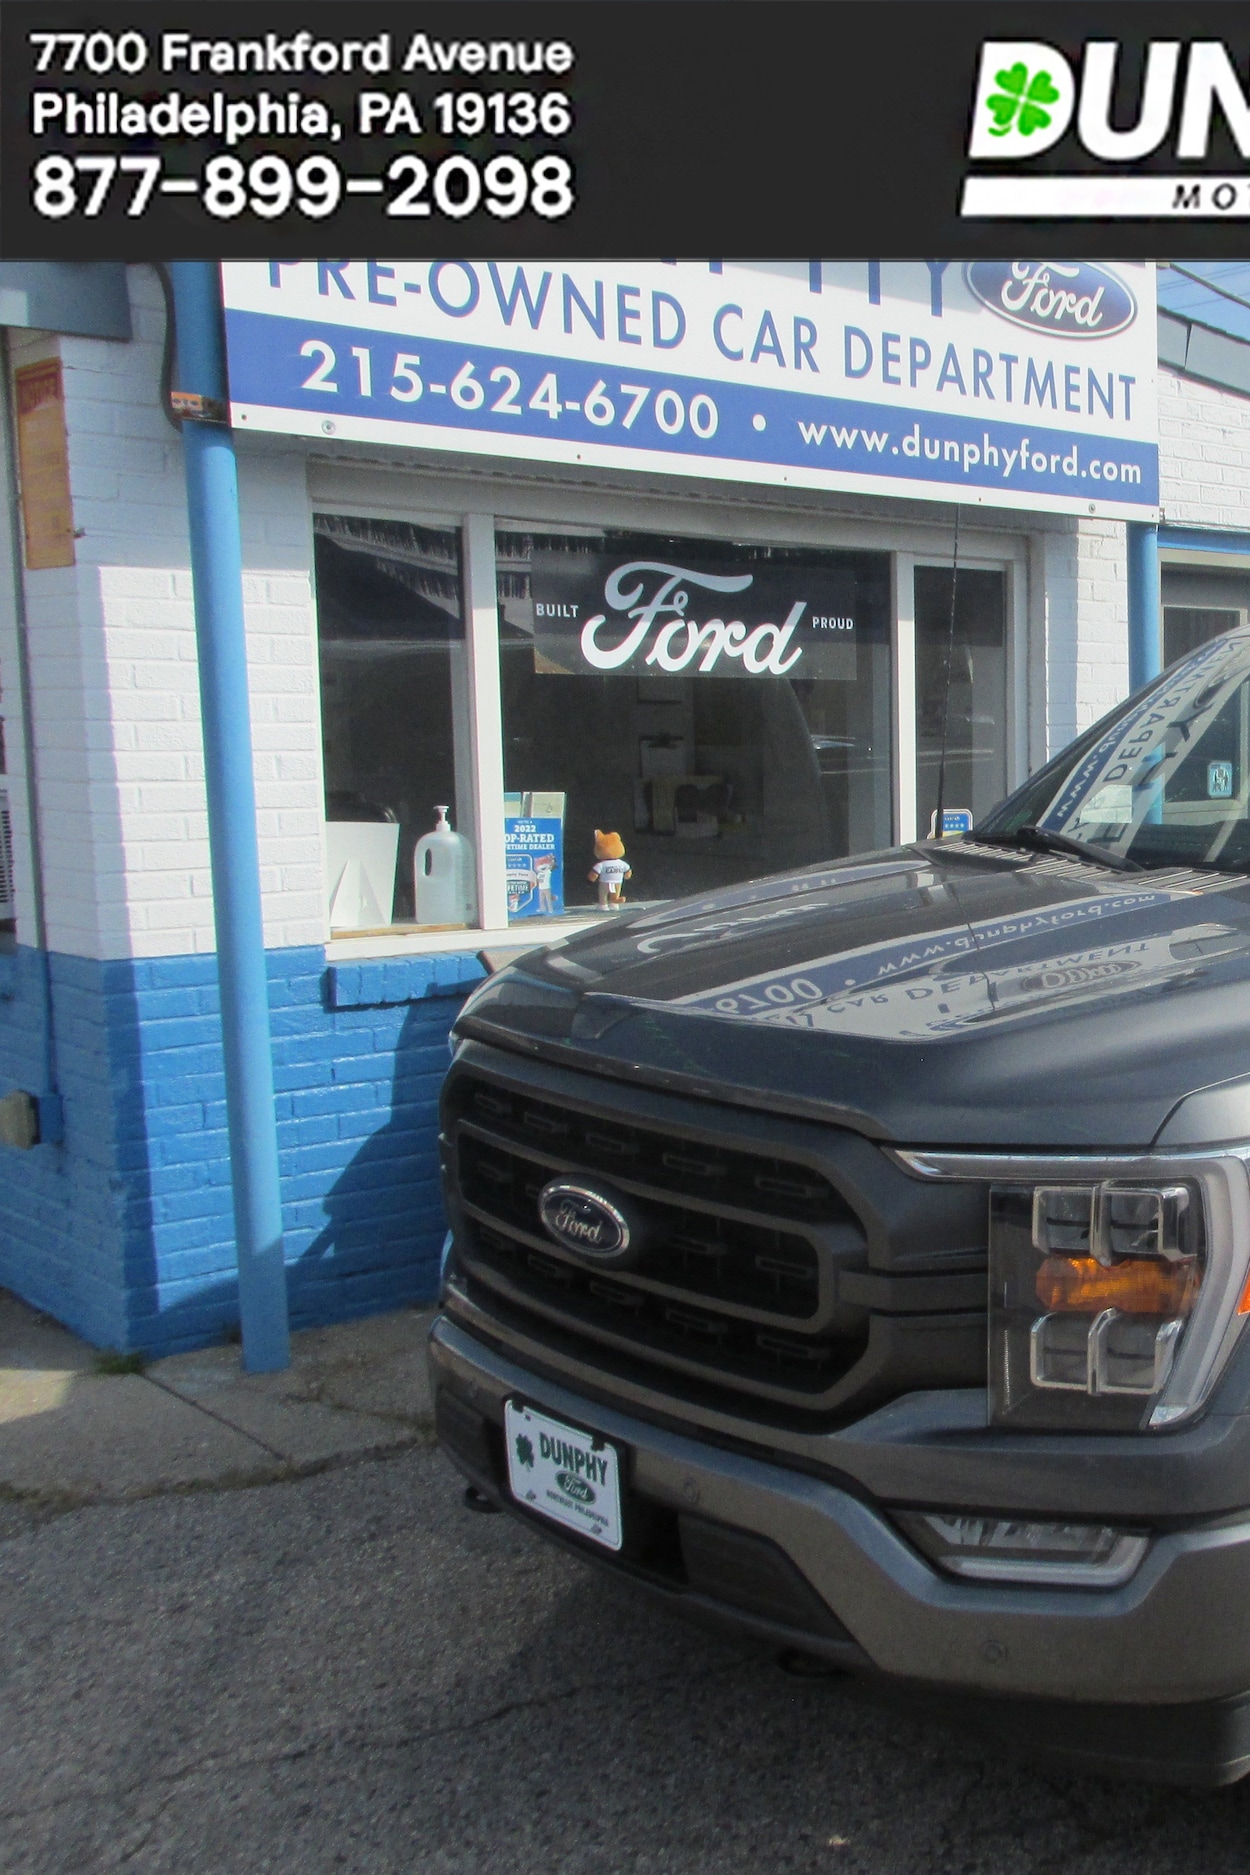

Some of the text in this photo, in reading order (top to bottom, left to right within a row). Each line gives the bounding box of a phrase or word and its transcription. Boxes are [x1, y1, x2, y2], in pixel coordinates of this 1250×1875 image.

[1001, 261, 1107, 328] Ford
[300, 340, 720, 440] 215-624-6700
[712, 303, 821, 374] CAR
[843, 325, 1137, 422] DEPARTMENT
[797, 423, 1142, 485] www.dunphyford.com
[535, 561, 854, 675] BUILT Ford PROUD
[504, 833, 555, 843] OP-RATED
[514, 824, 537, 833] 2022
[555, 1198, 602, 1244] Ford
[539, 1431, 608, 1486] DUNPHY
[563, 1475, 589, 1500] Ford
